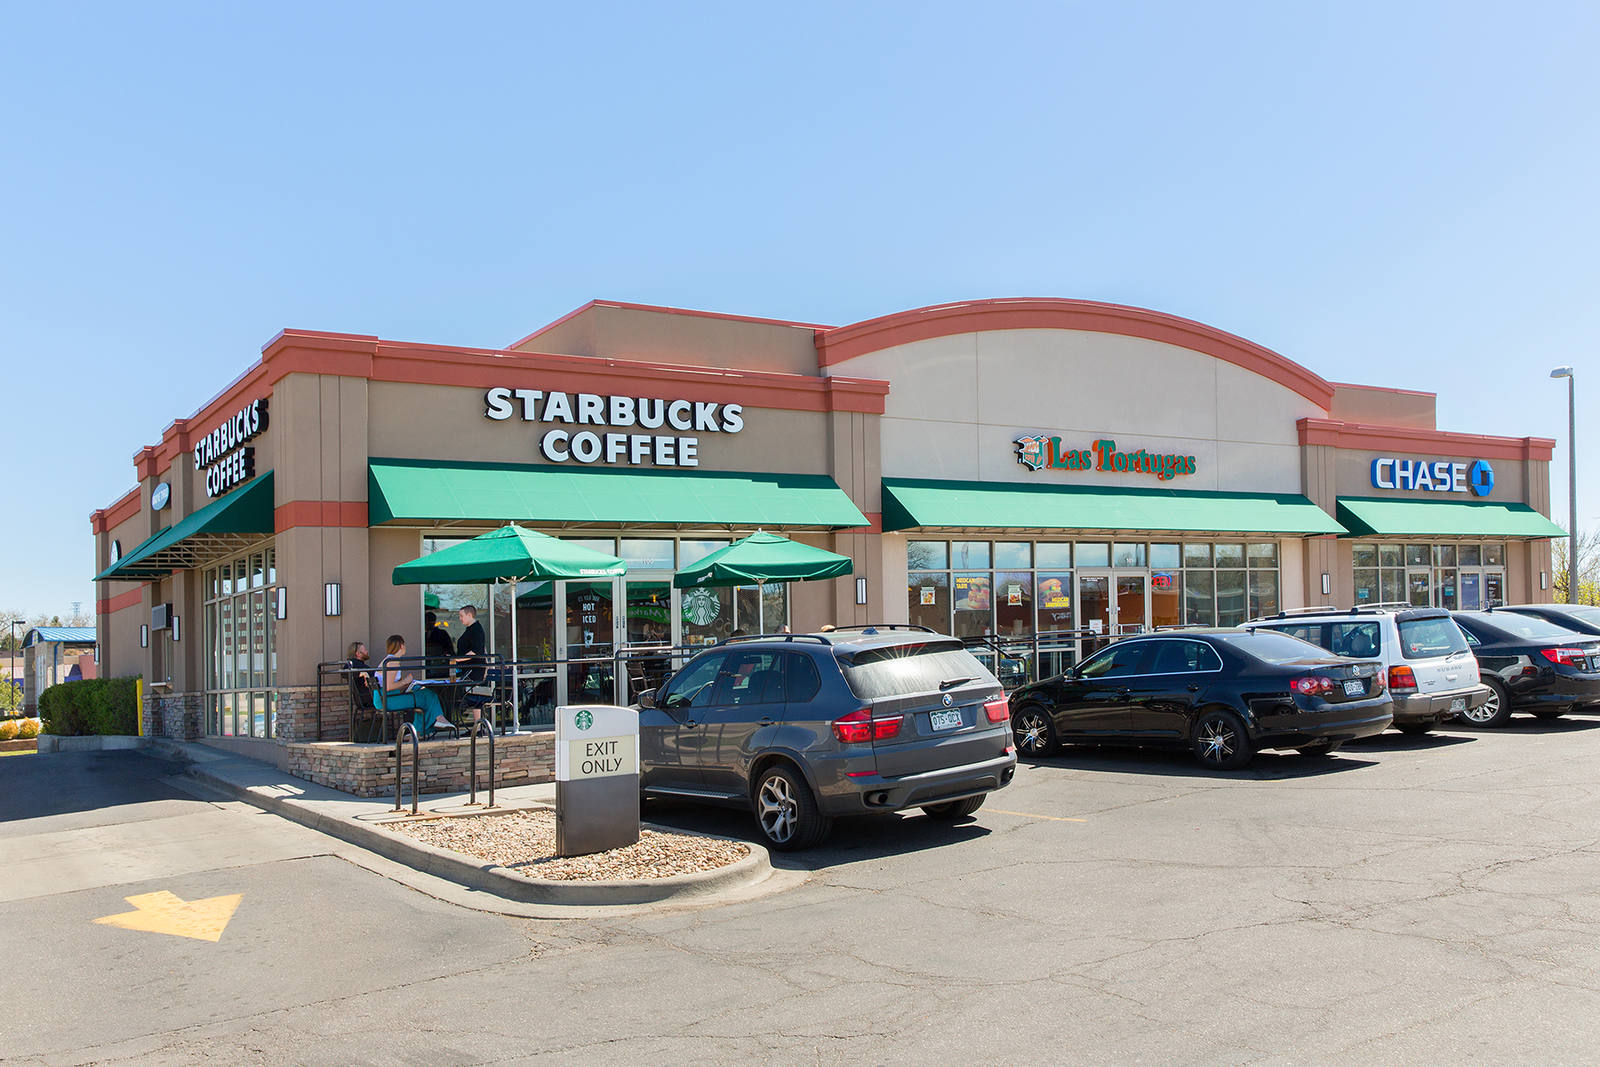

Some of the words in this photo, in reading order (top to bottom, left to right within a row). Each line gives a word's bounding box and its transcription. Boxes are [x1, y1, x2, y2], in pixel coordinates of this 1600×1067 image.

[485, 387, 744, 433] STARBUCKS
[194, 399, 262, 470] STARBUCKS
[541, 429, 699, 467] COFFEE
[206, 447, 248, 498] COFFEE
[1047, 436, 1092, 469] Las
[1093, 439, 1196, 480] Tortugas
[1371, 458, 1467, 492] CHASE
[582, 603, 595, 611] HOT
[582, 615, 597, 624] ICED
[581, 758, 622, 774] ONLY
[586, 741, 618, 757] EXIT
